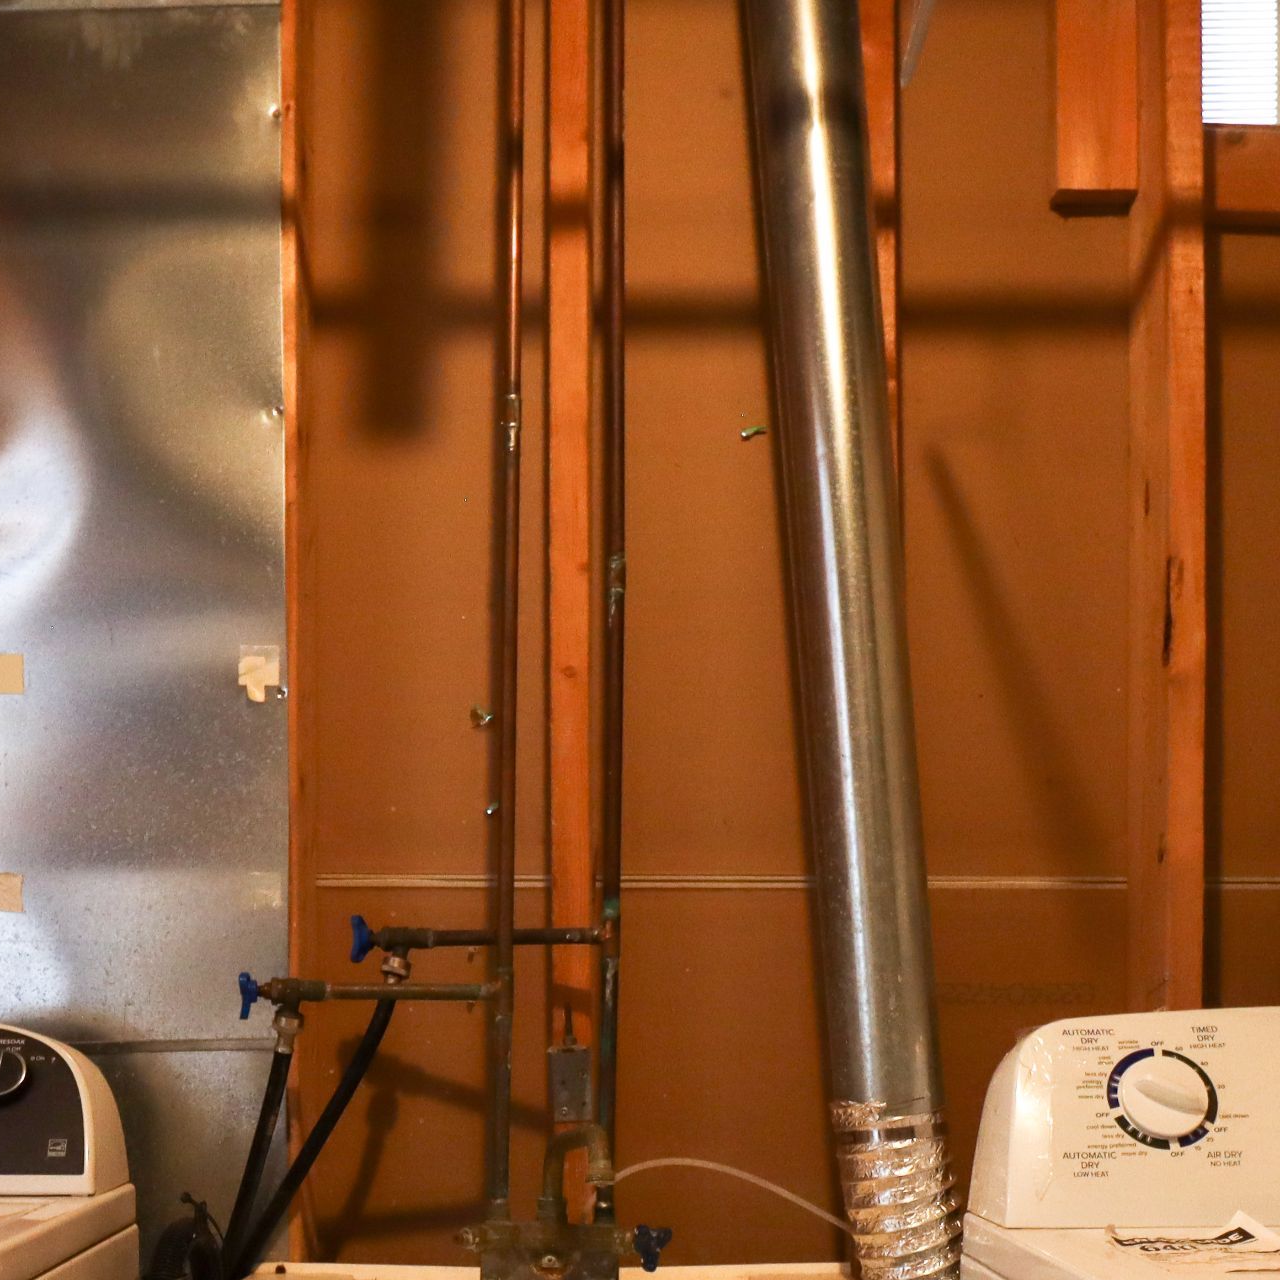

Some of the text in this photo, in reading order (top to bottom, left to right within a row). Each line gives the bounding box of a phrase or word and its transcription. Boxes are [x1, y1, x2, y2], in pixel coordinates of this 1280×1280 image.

[1062, 1028, 1115, 1036] AUTOMATIC
[1190, 1025, 1218, 1034] TIMED
[1080, 1037, 1099, 1045] DRY
[1062, 1151, 1117, 1160] AUTOMATIC
[1081, 1161, 1100, 1169] DRY
